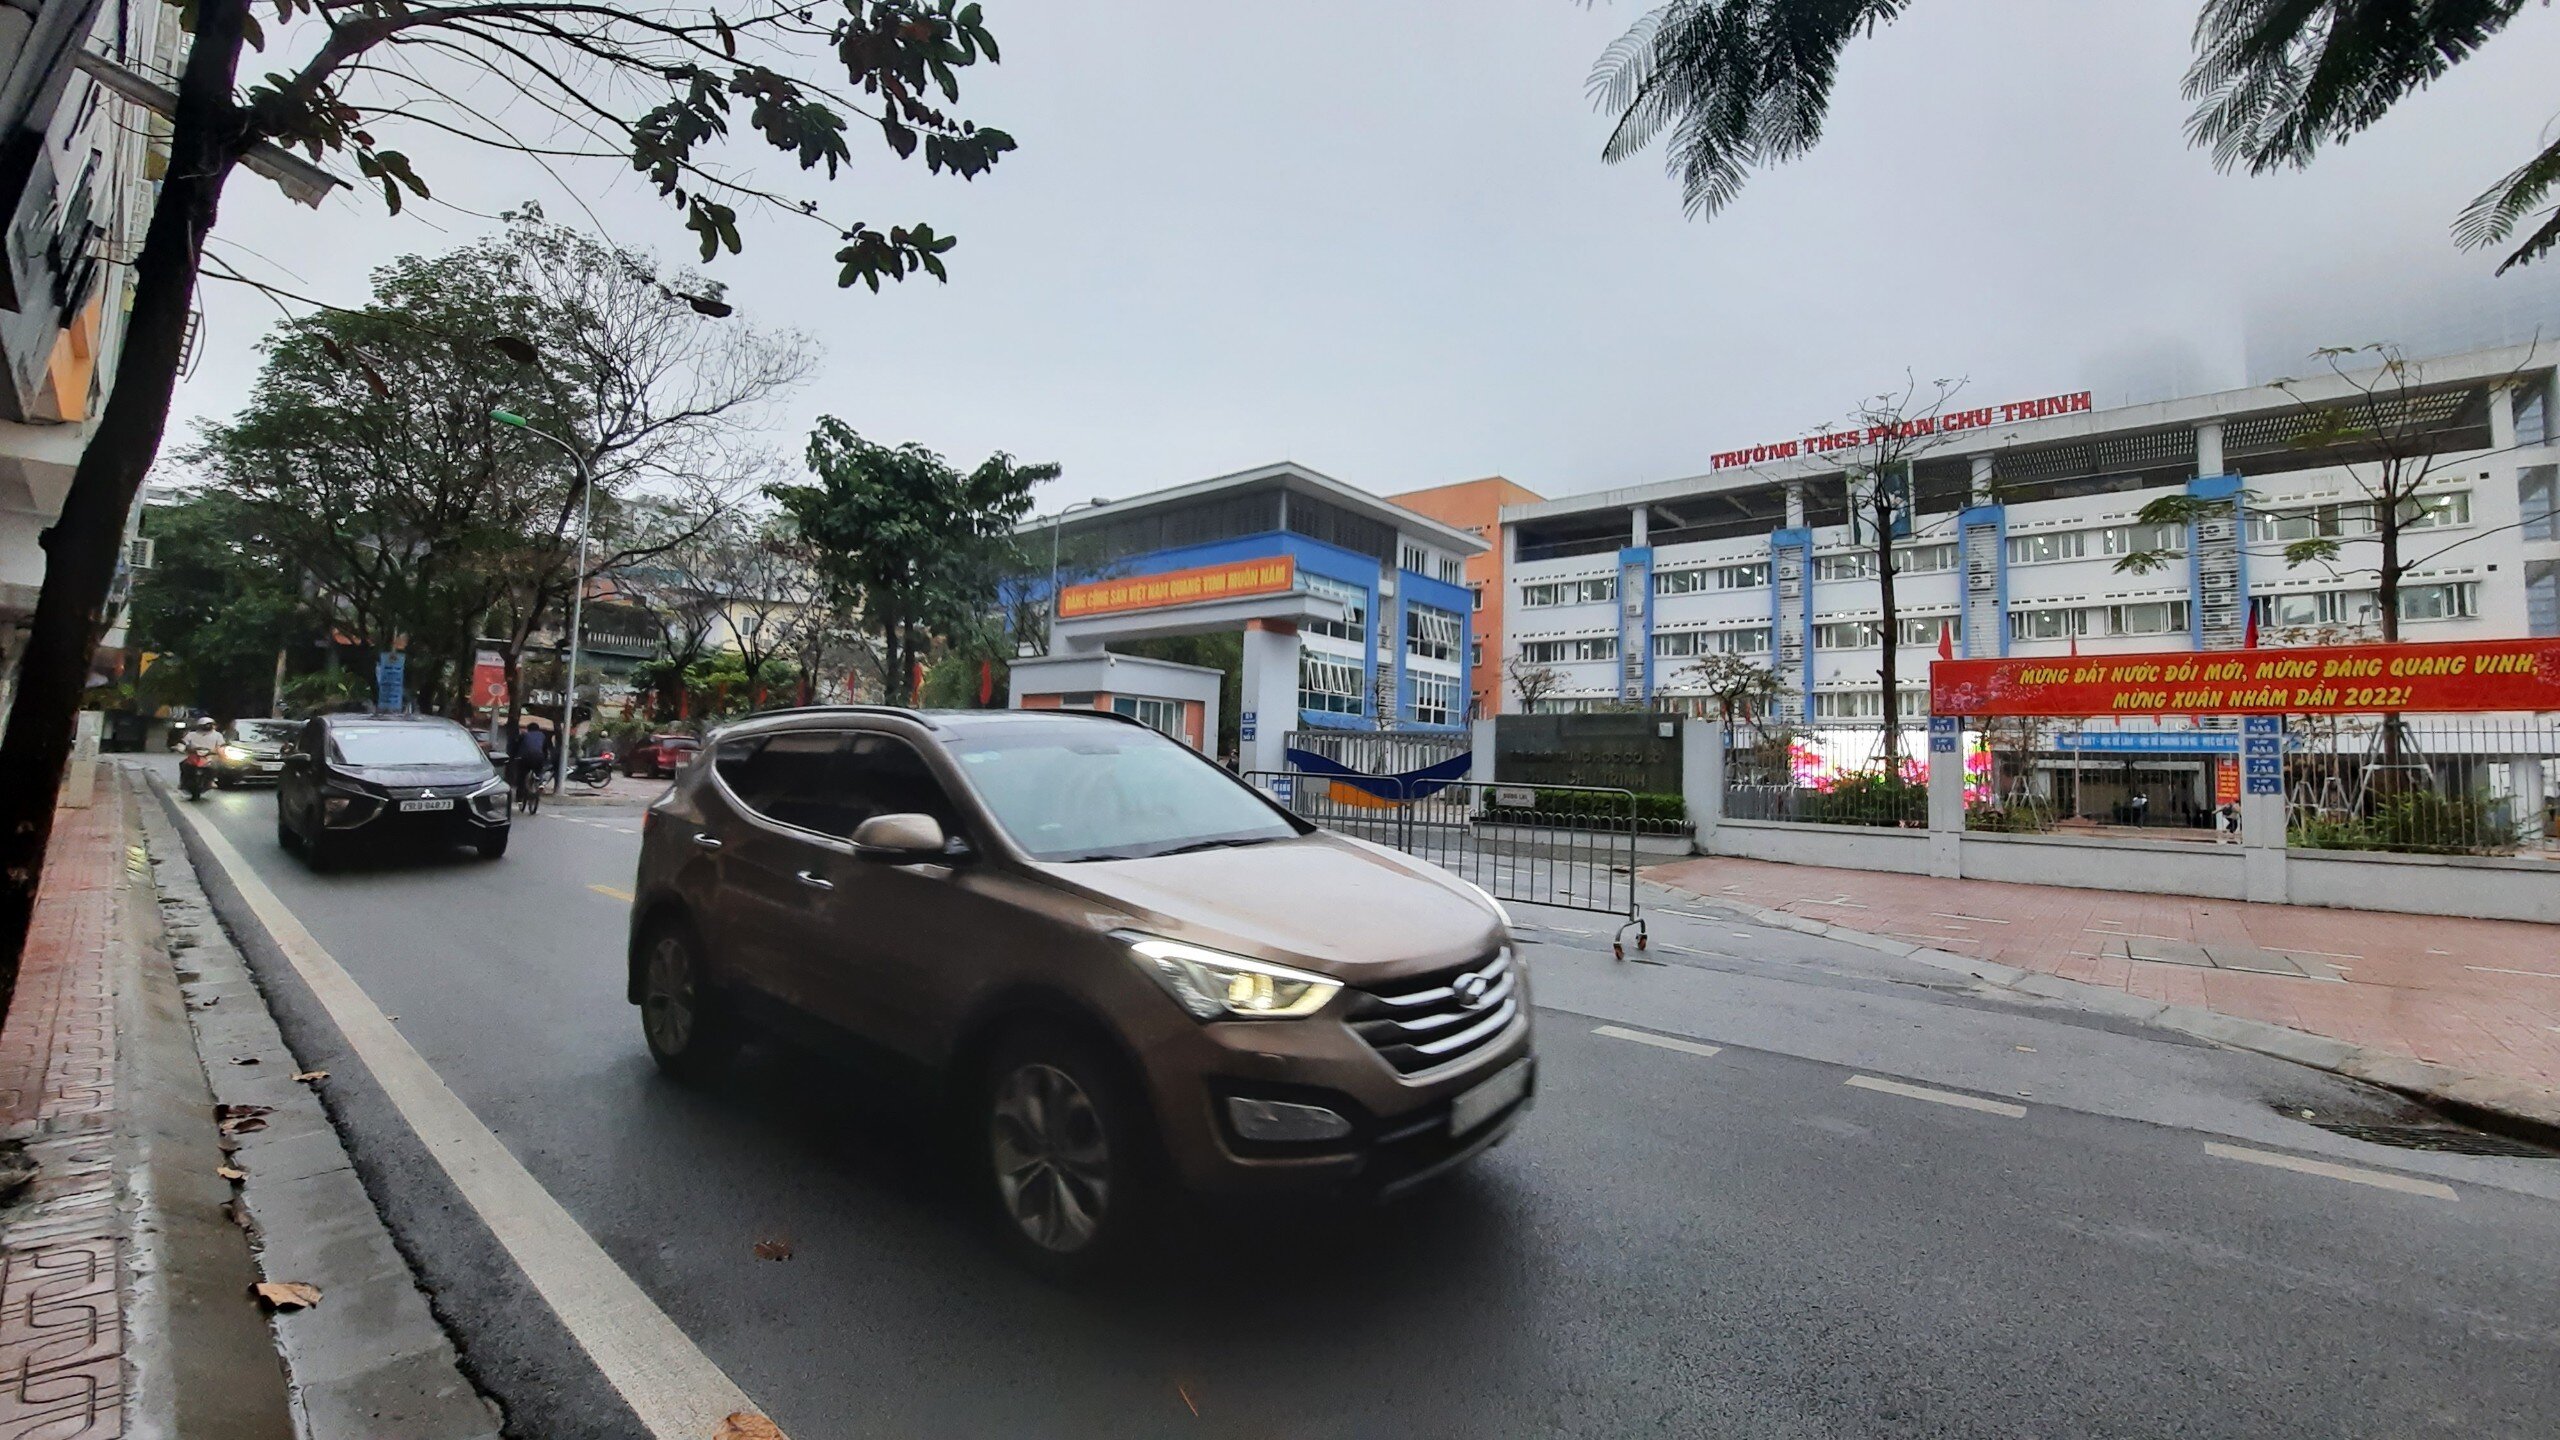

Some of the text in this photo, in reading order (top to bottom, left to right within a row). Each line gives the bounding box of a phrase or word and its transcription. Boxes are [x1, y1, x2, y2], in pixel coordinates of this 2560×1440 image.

[1711, 391, 2091, 470] TRƯỜNG THCS PHAN CHU TRINH
[2020, 653, 2540, 684] MỪNG ĐẤT NƯỚC ĐỔI MỚI, MỪNG ĐẢNG QUANG VINH,
[2112, 679, 2413, 709] MỪNG XUÂN NHÂM DẦN 2022!
